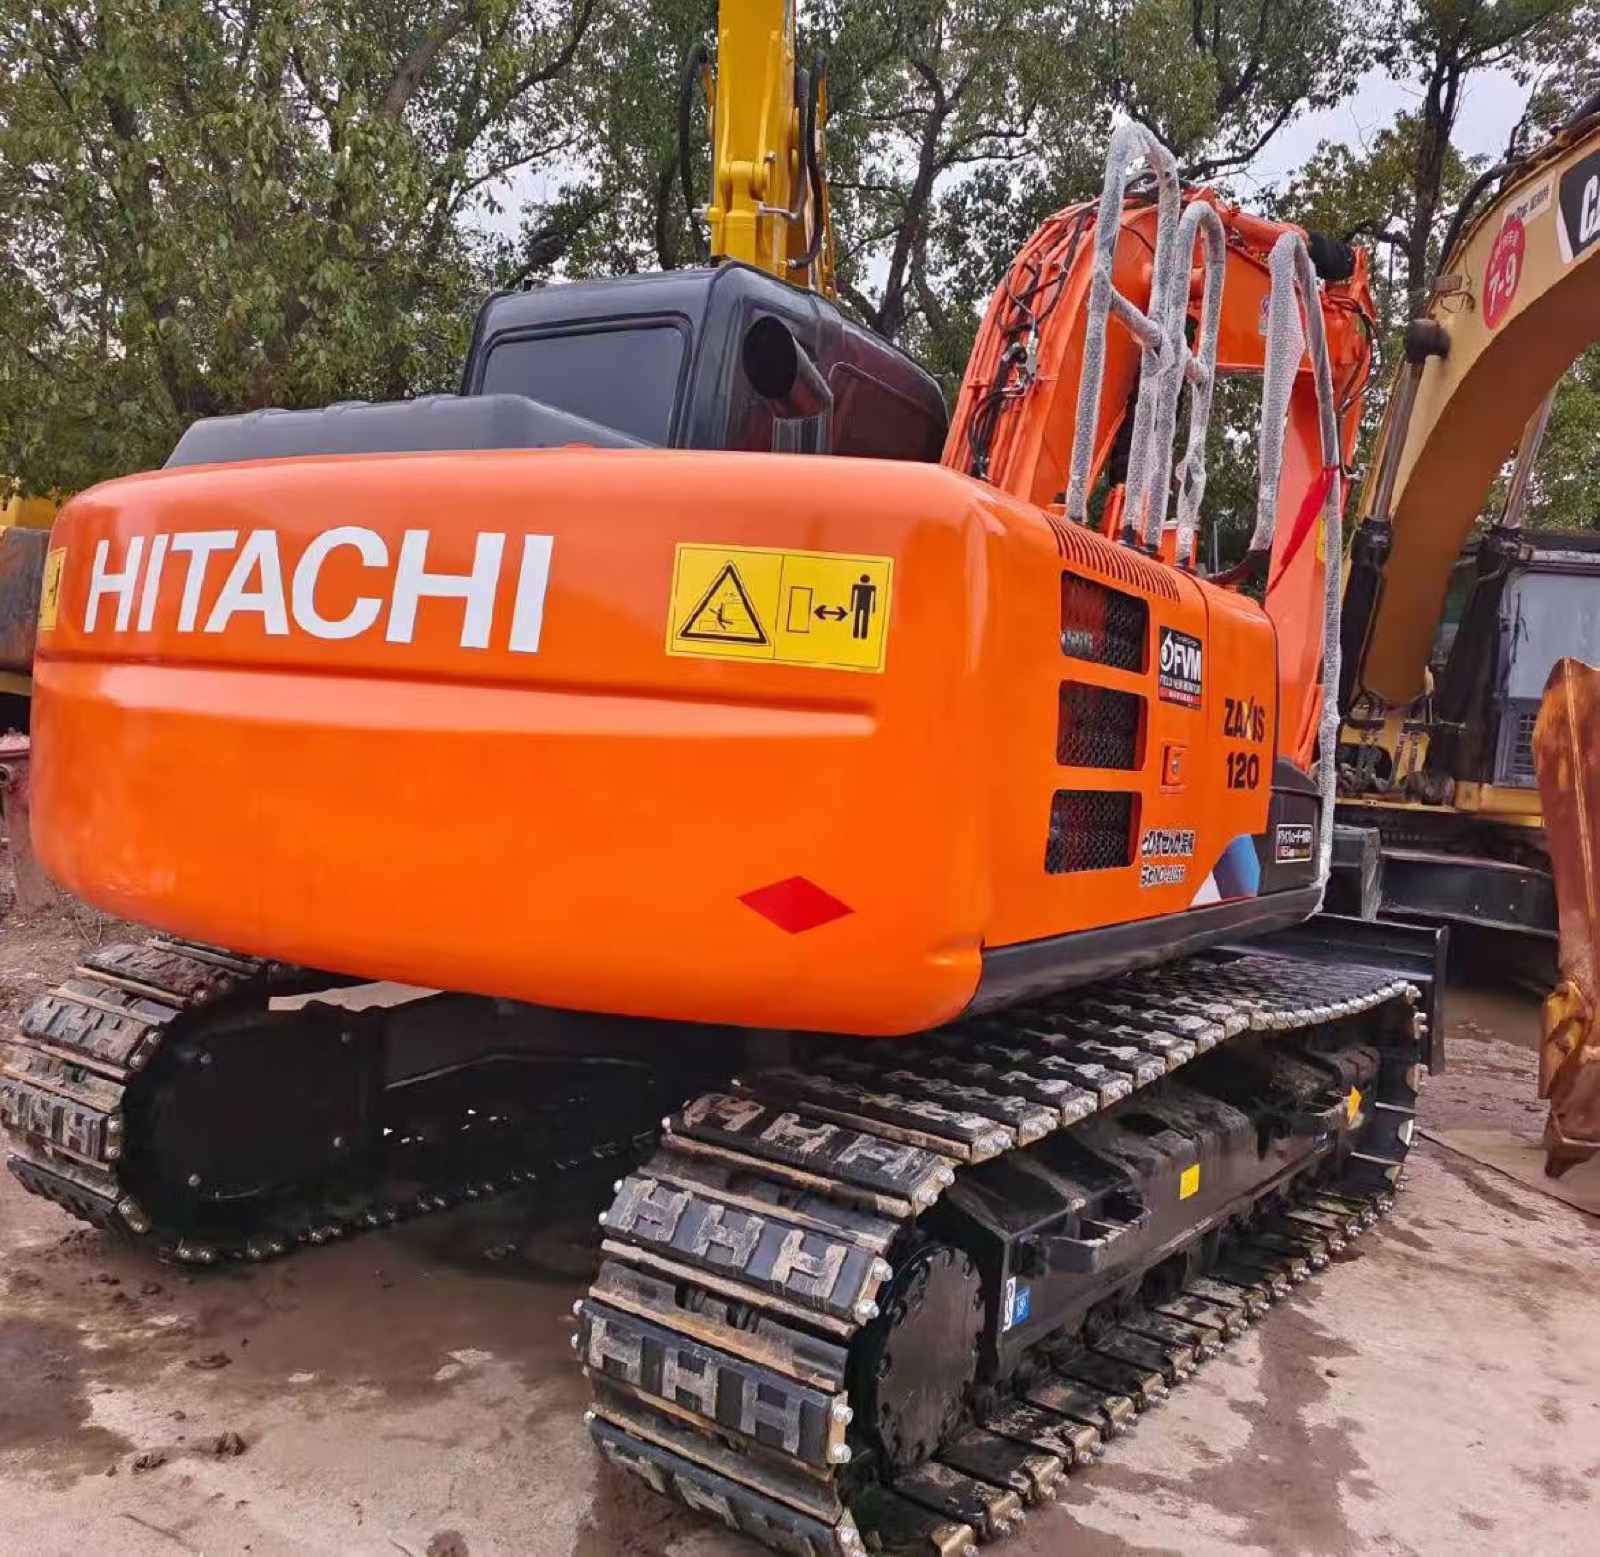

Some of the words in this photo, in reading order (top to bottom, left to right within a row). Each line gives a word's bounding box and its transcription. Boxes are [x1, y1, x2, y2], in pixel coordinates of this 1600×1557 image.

[83, 525, 554, 653] HITACHI
[1174, 643, 1201, 682] FVM
[1224, 696, 1265, 743] ZAXIS
[1227, 752, 1259, 790] 120
